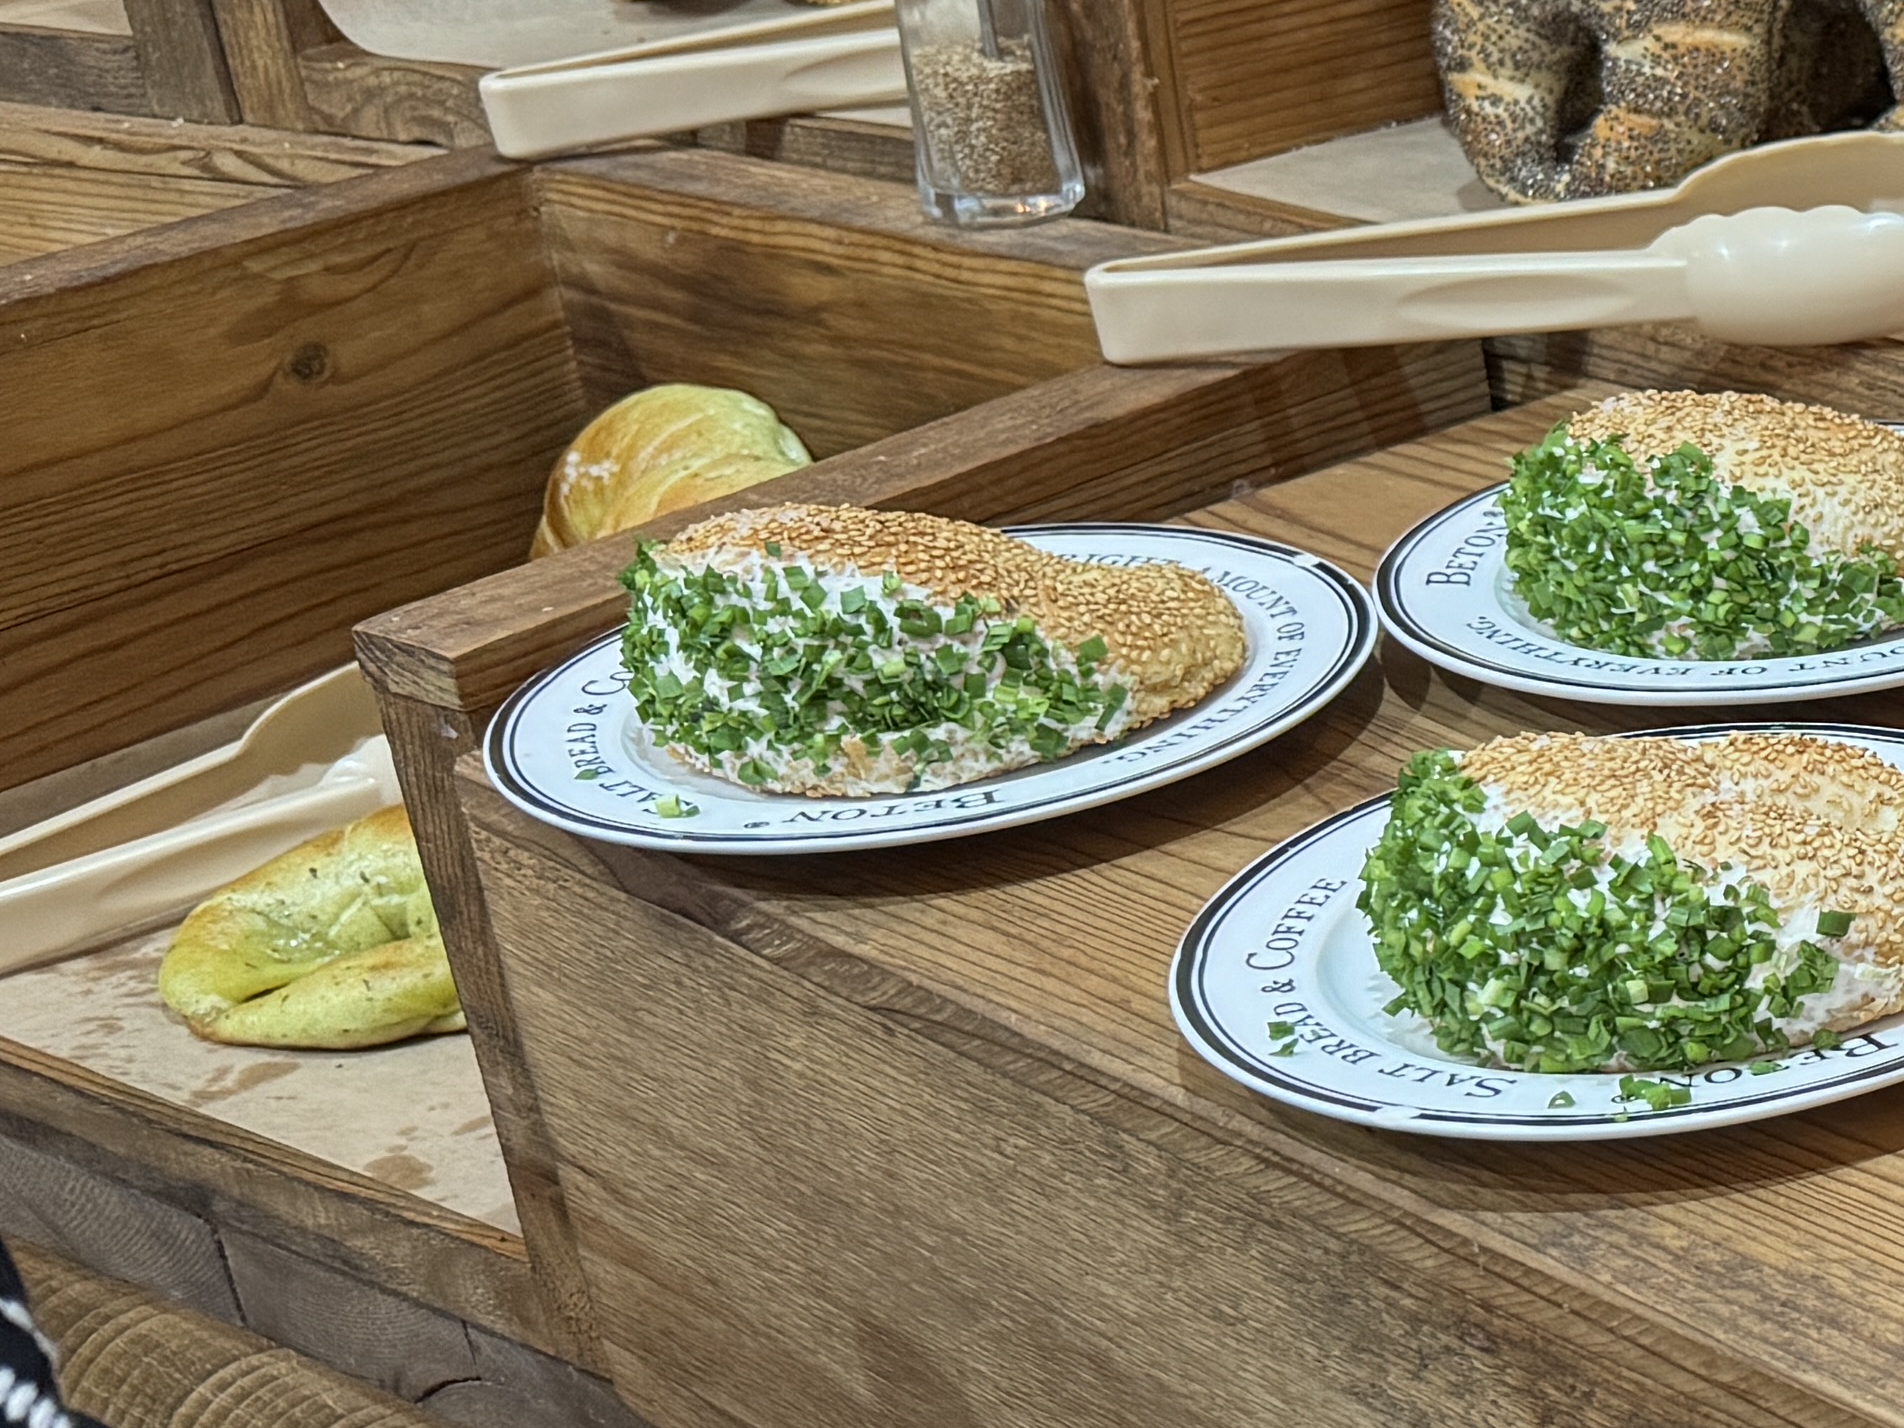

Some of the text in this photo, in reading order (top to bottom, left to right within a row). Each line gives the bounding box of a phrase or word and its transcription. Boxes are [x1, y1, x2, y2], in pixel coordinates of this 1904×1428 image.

[1246, 877, 1518, 1099] SALT BREAD & COFFEE
